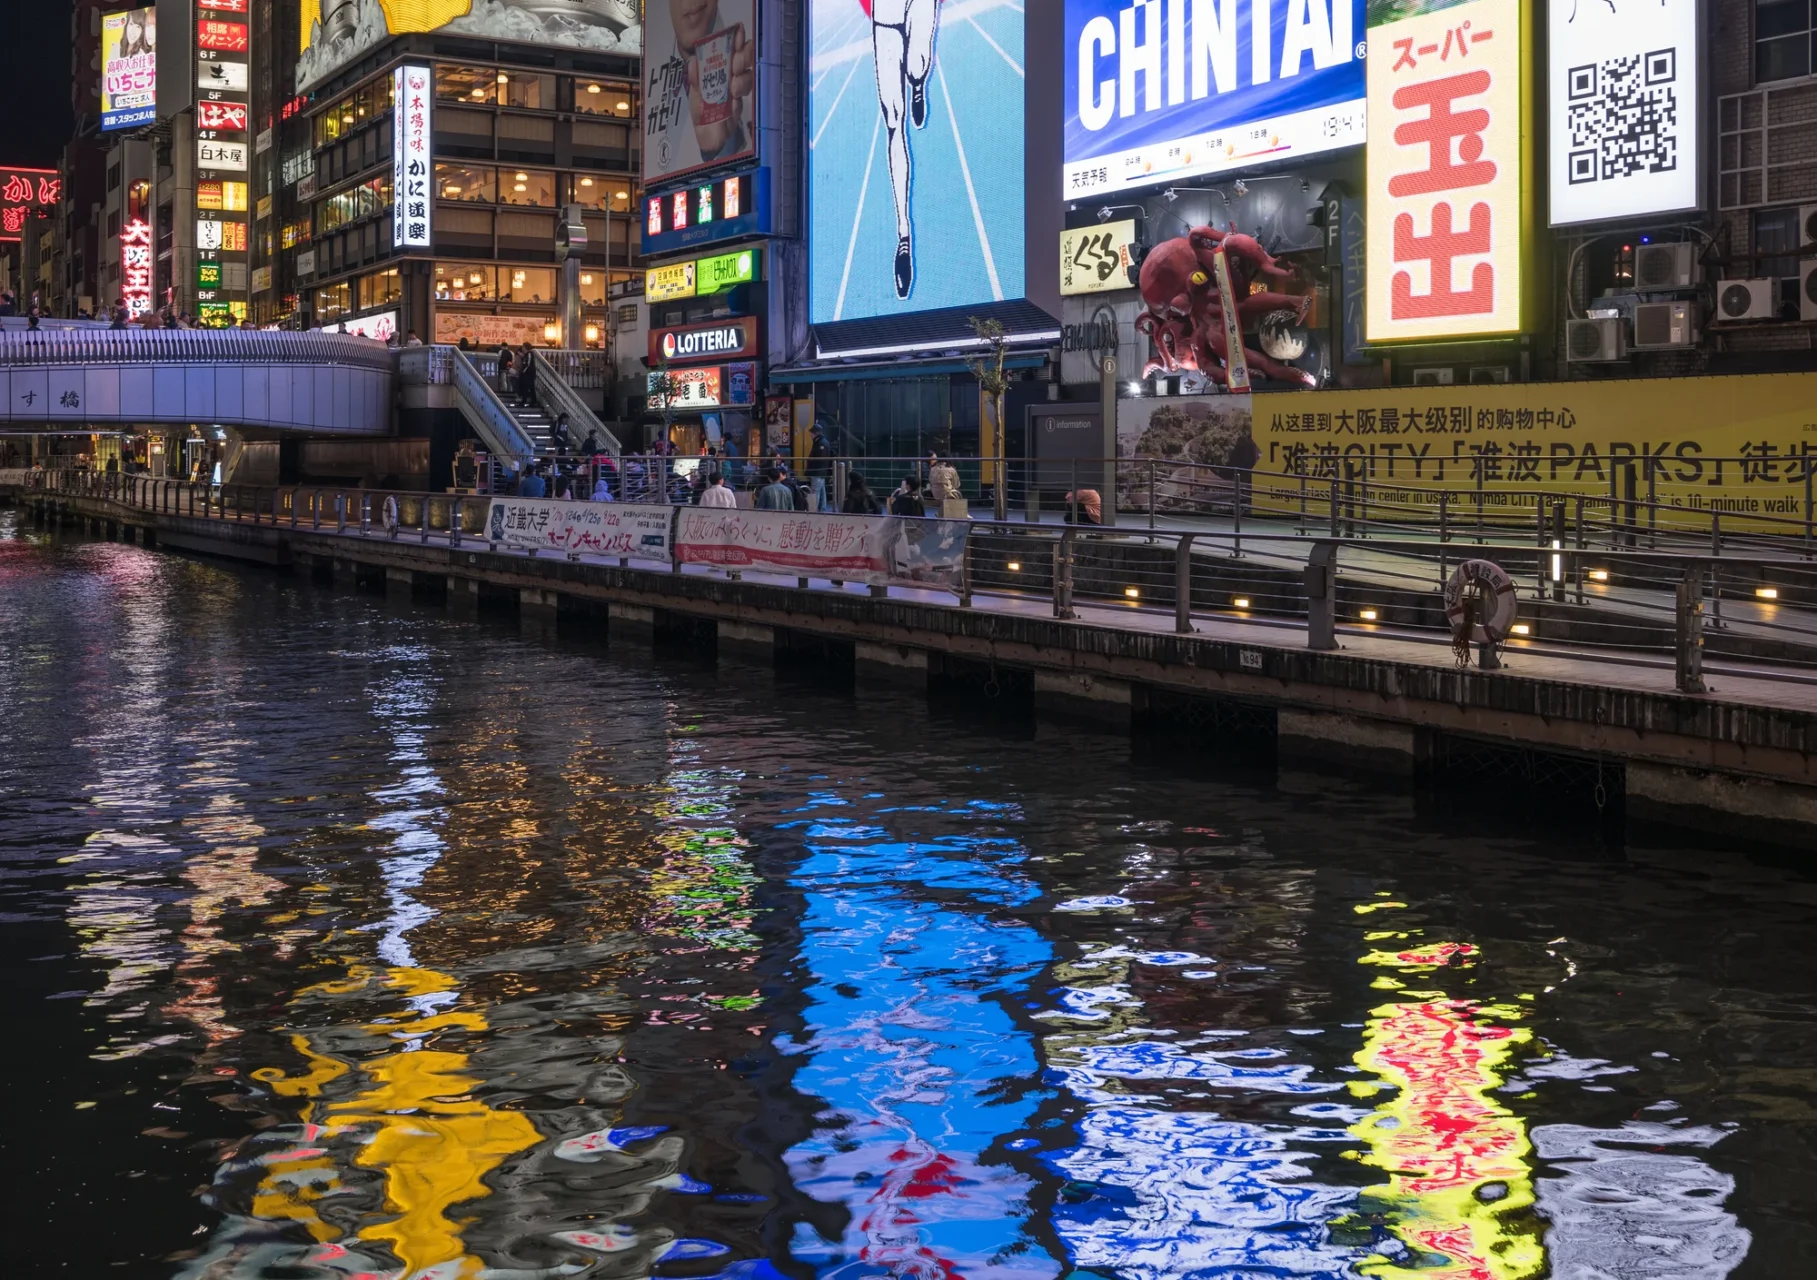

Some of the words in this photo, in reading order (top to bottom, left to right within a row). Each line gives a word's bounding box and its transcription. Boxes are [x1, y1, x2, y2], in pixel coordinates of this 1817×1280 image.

[199, 34, 247, 49] ダイニング
[1392, 19, 1493, 72] スーパー
[107, 54, 155, 73] 高収入お仕事
[208, 91, 221, 100] 5F
[409, 95, 425, 152] 本場の味
[201, 145, 243, 162] 白木屋
[1388, 69, 1497, 320] 玉出
[677, 328, 738, 354] LOTTERIA
[1056, 420, 1092, 429] information
[1271, 405, 1577, 435] 从这里到大阪最大级别的购物中心
[1379, 490, 1409, 504] center
[1414, 491, 1422, 504] in
[1427, 491, 1461, 505] Oska.
[1687, 493, 1759, 513] 10-minute
[1763, 495, 1799, 513] walk
[504, 506, 550, 532] 近畿大学
